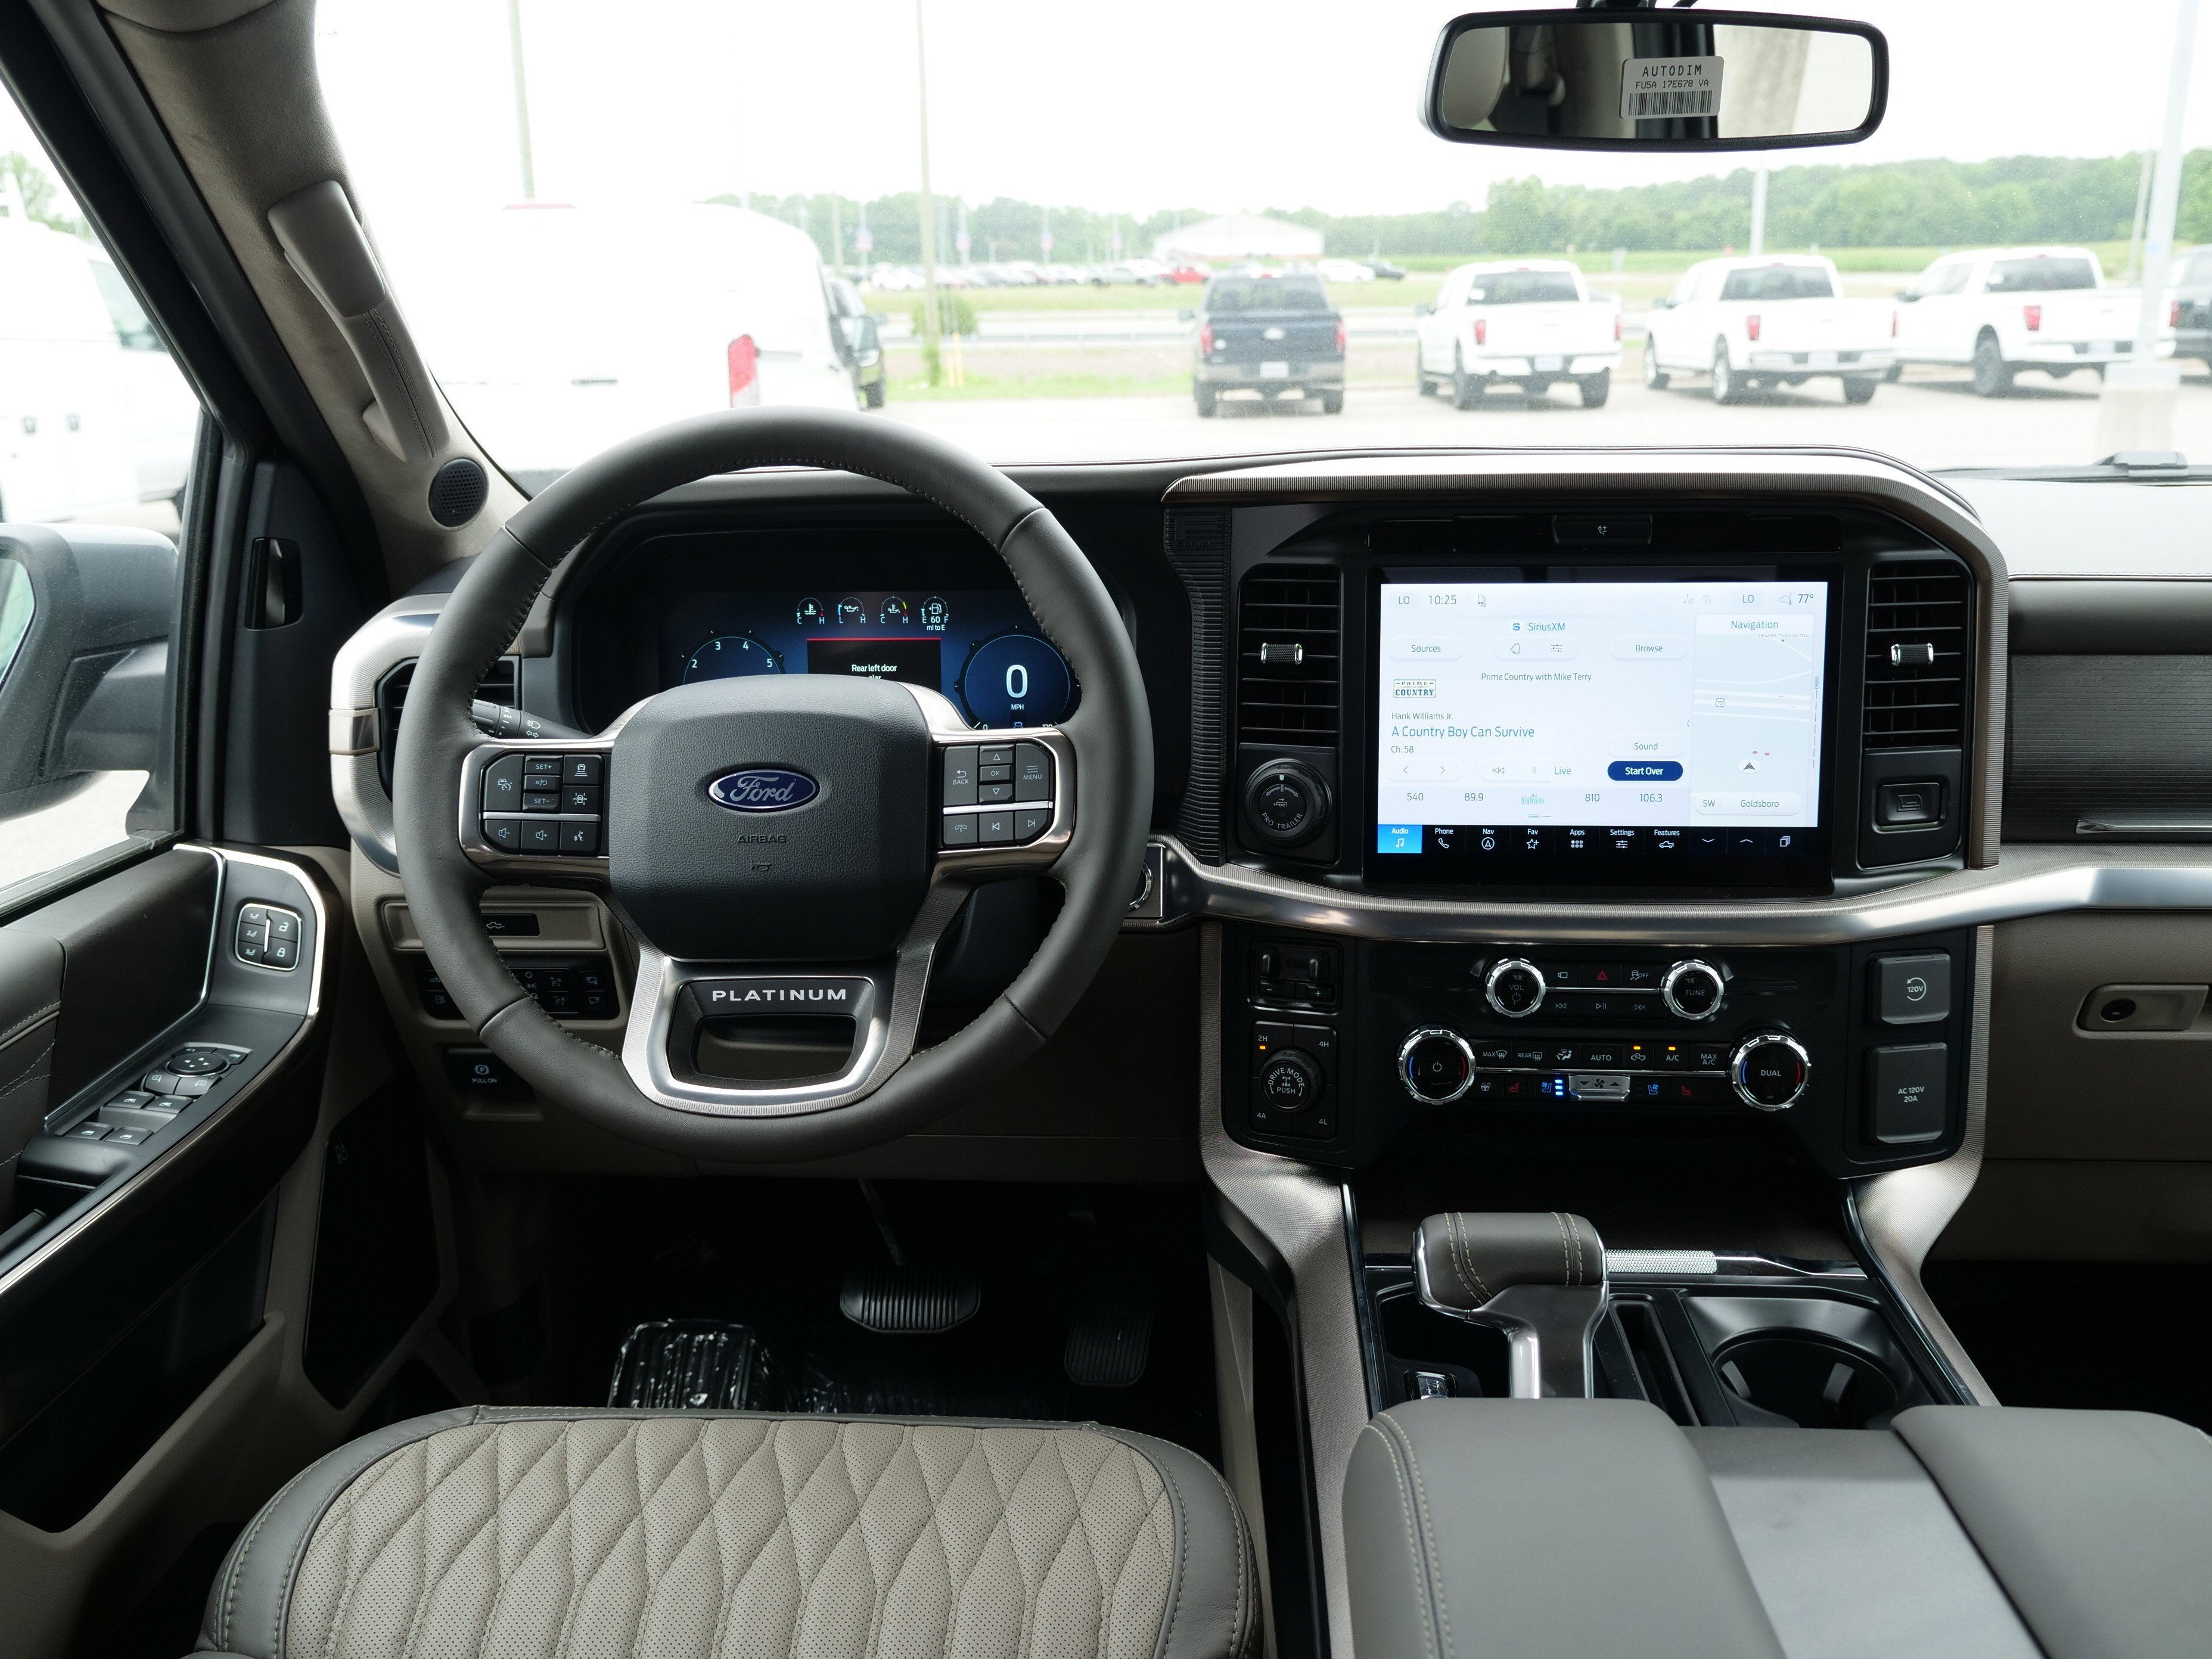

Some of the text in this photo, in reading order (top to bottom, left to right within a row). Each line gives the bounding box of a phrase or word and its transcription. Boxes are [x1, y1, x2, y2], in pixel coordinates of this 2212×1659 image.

[1642, 64, 1702, 77] AUTODIM
[1635, 79, 1709, 89] FU5A 17E678 VA
[1398, 595, 1457, 605] LO 10:25
[1742, 595, 1754, 603] LO
[1528, 622, 1565, 632] SiriusXM
[1731, 620, 1779, 630] Navigation
[715, 641, 721, 650] 3
[742, 641, 749, 650] 4
[1411, 644, 1441, 653] Sources
[1635, 644, 1663, 653] Browse
[691, 659, 697, 669] 2
[766, 658, 772, 667] 5
[1005, 664, 1029, 698] 0
[1481, 673, 1592, 682] Prime Country with Mike Terry
[1391, 726, 1534, 739] A Country Boy Can Survive
[1391, 745, 1403, 753] Ch.
[1634, 742, 1658, 750] Sound
[1554, 766, 1571, 775] Live
[1625, 767, 1664, 775] Start Over
[730, 775, 796, 801] Ford
[1406, 793, 1484, 801] 540 89.9
[1521, 796, 1545, 804] highway
[1585, 793, 1663, 803] 810 106.3
[1703, 799, 1779, 808] SW Goldsboro
[1261, 812, 1303, 830] PRO TRAILER
[737, 834, 787, 844] AIRBAG
[712, 989, 846, 1002] PLATINUM
[1267, 1067, 1305, 1088] DRIVE MODE
[1908, 1086, 1925, 1094] 120V
